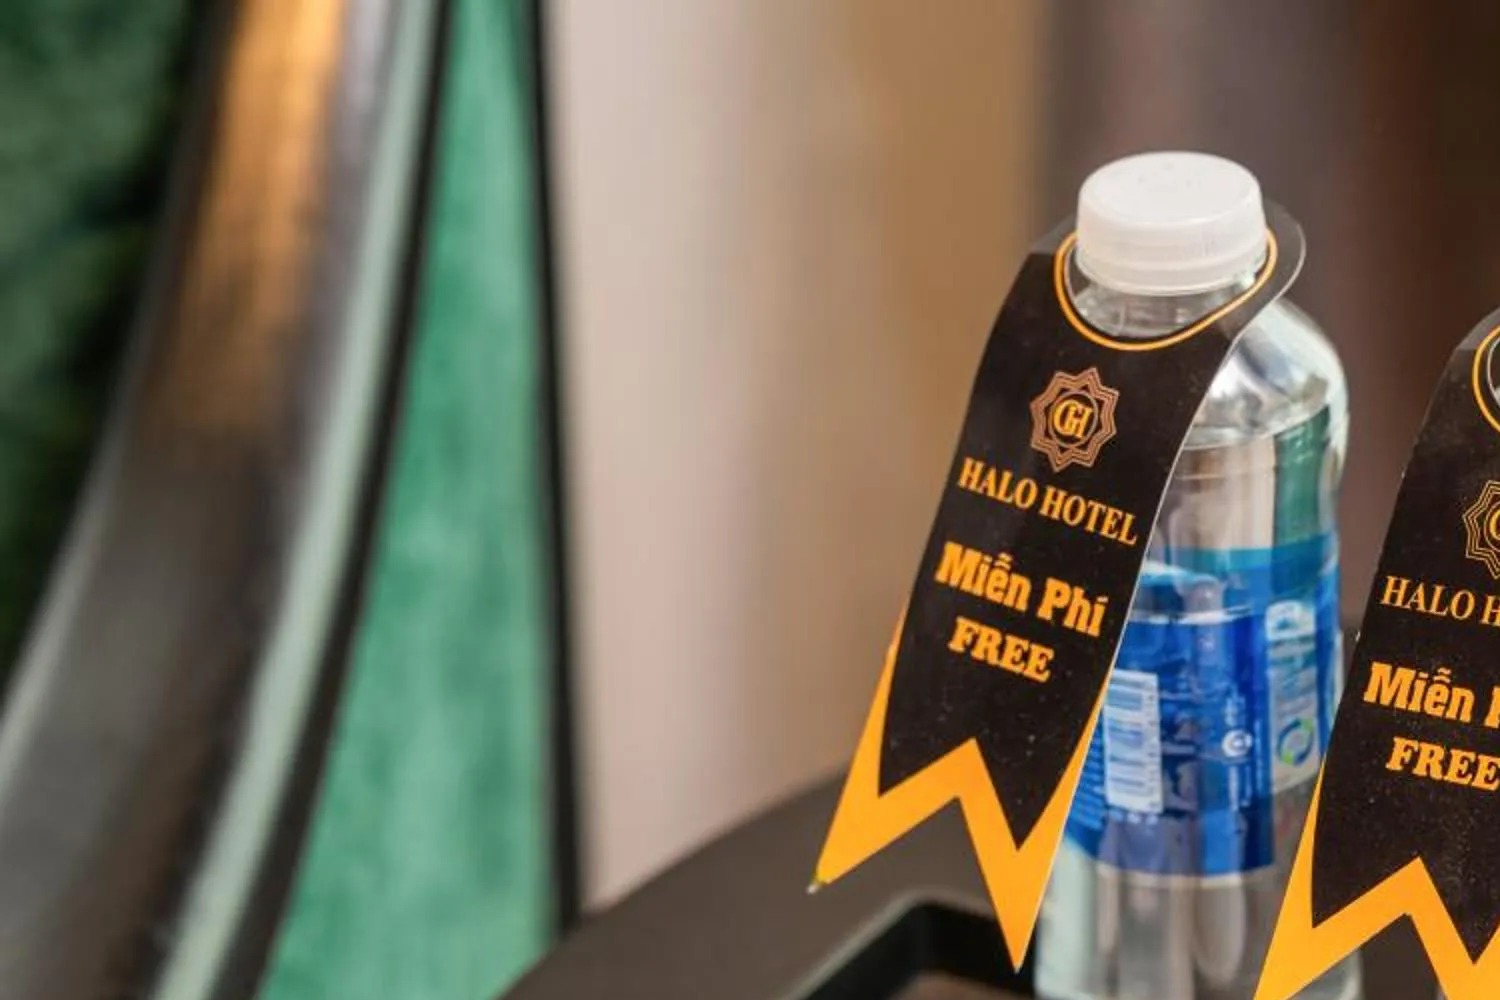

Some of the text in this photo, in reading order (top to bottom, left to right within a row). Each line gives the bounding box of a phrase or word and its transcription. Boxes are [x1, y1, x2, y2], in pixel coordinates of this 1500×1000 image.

[958, 456, 1138, 546] HALO HOTEL
[935, 542, 1108, 637] Miễn Phí
[1379, 575, 1475, 620] HALO
[947, 616, 1055, 682] FREE
[1363, 661, 1476, 724] Miễn
